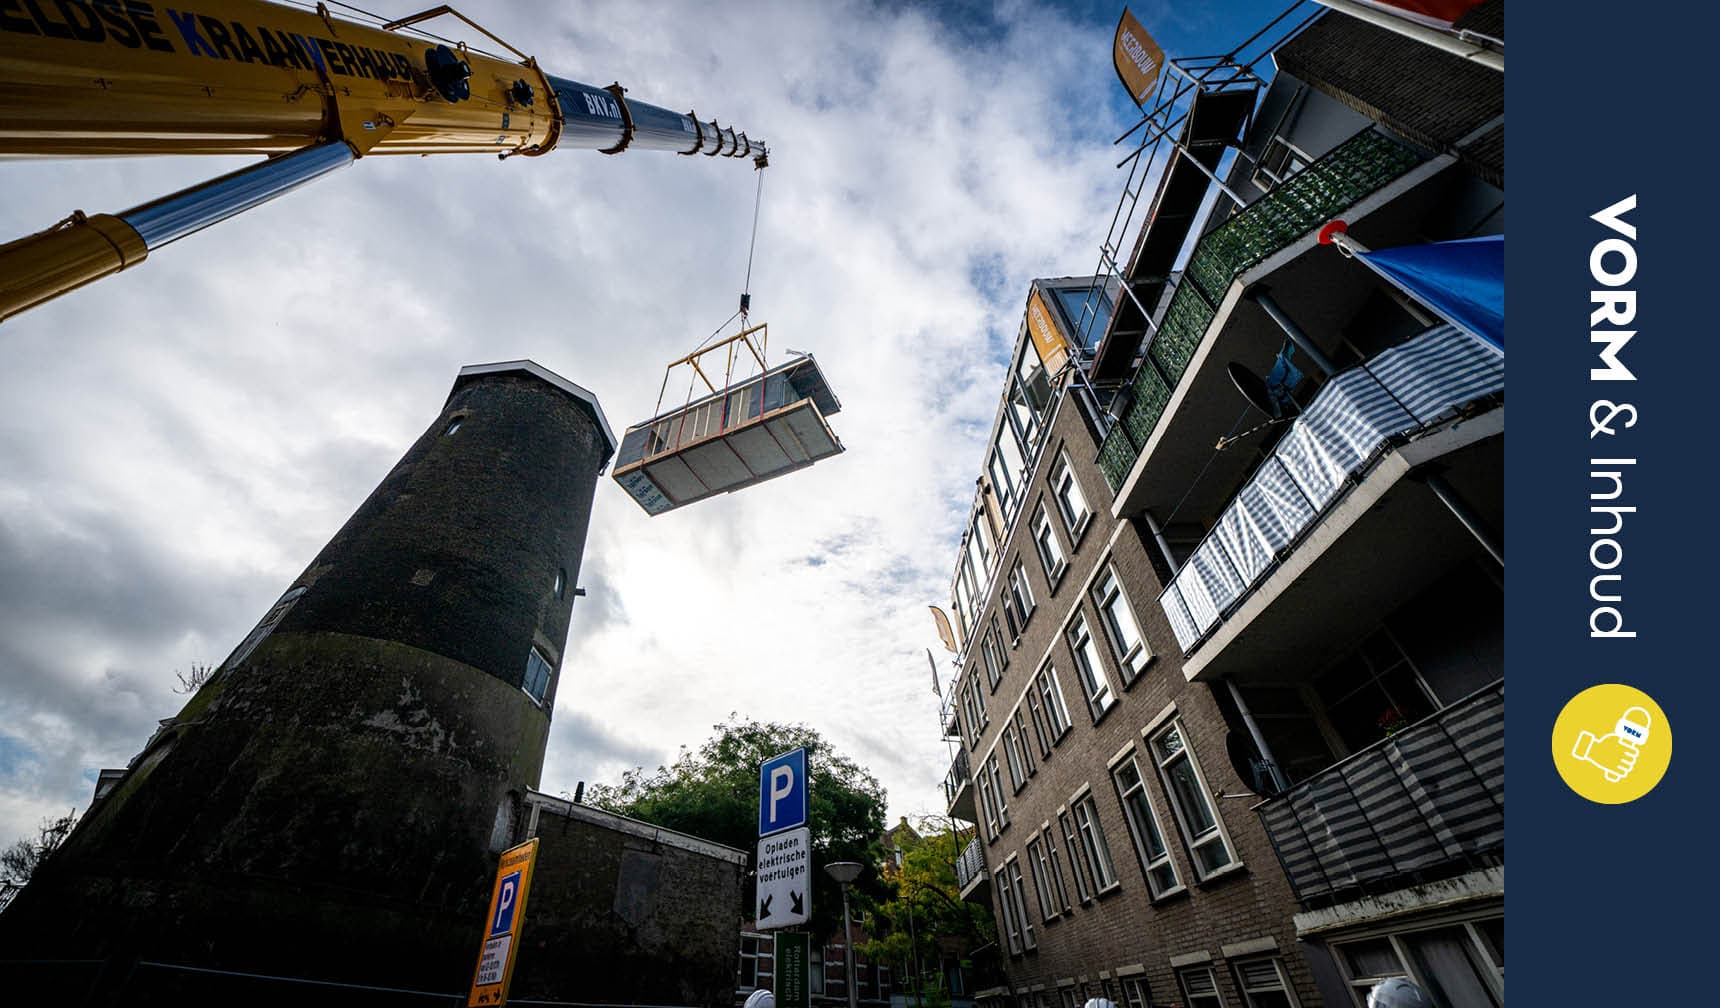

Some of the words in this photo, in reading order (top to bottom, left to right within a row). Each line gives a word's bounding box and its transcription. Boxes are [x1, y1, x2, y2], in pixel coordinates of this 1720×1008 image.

[166, 8, 414, 81] KRAANVERHUUR
[583, 92, 622, 120] BKV.nl
[770, 764, 794, 823] P
[759, 850, 806, 870] elektrische
[765, 838, 799, 855] Opladen
[760, 865, 805, 883] voertuigen
[496, 882, 514, 929] P
